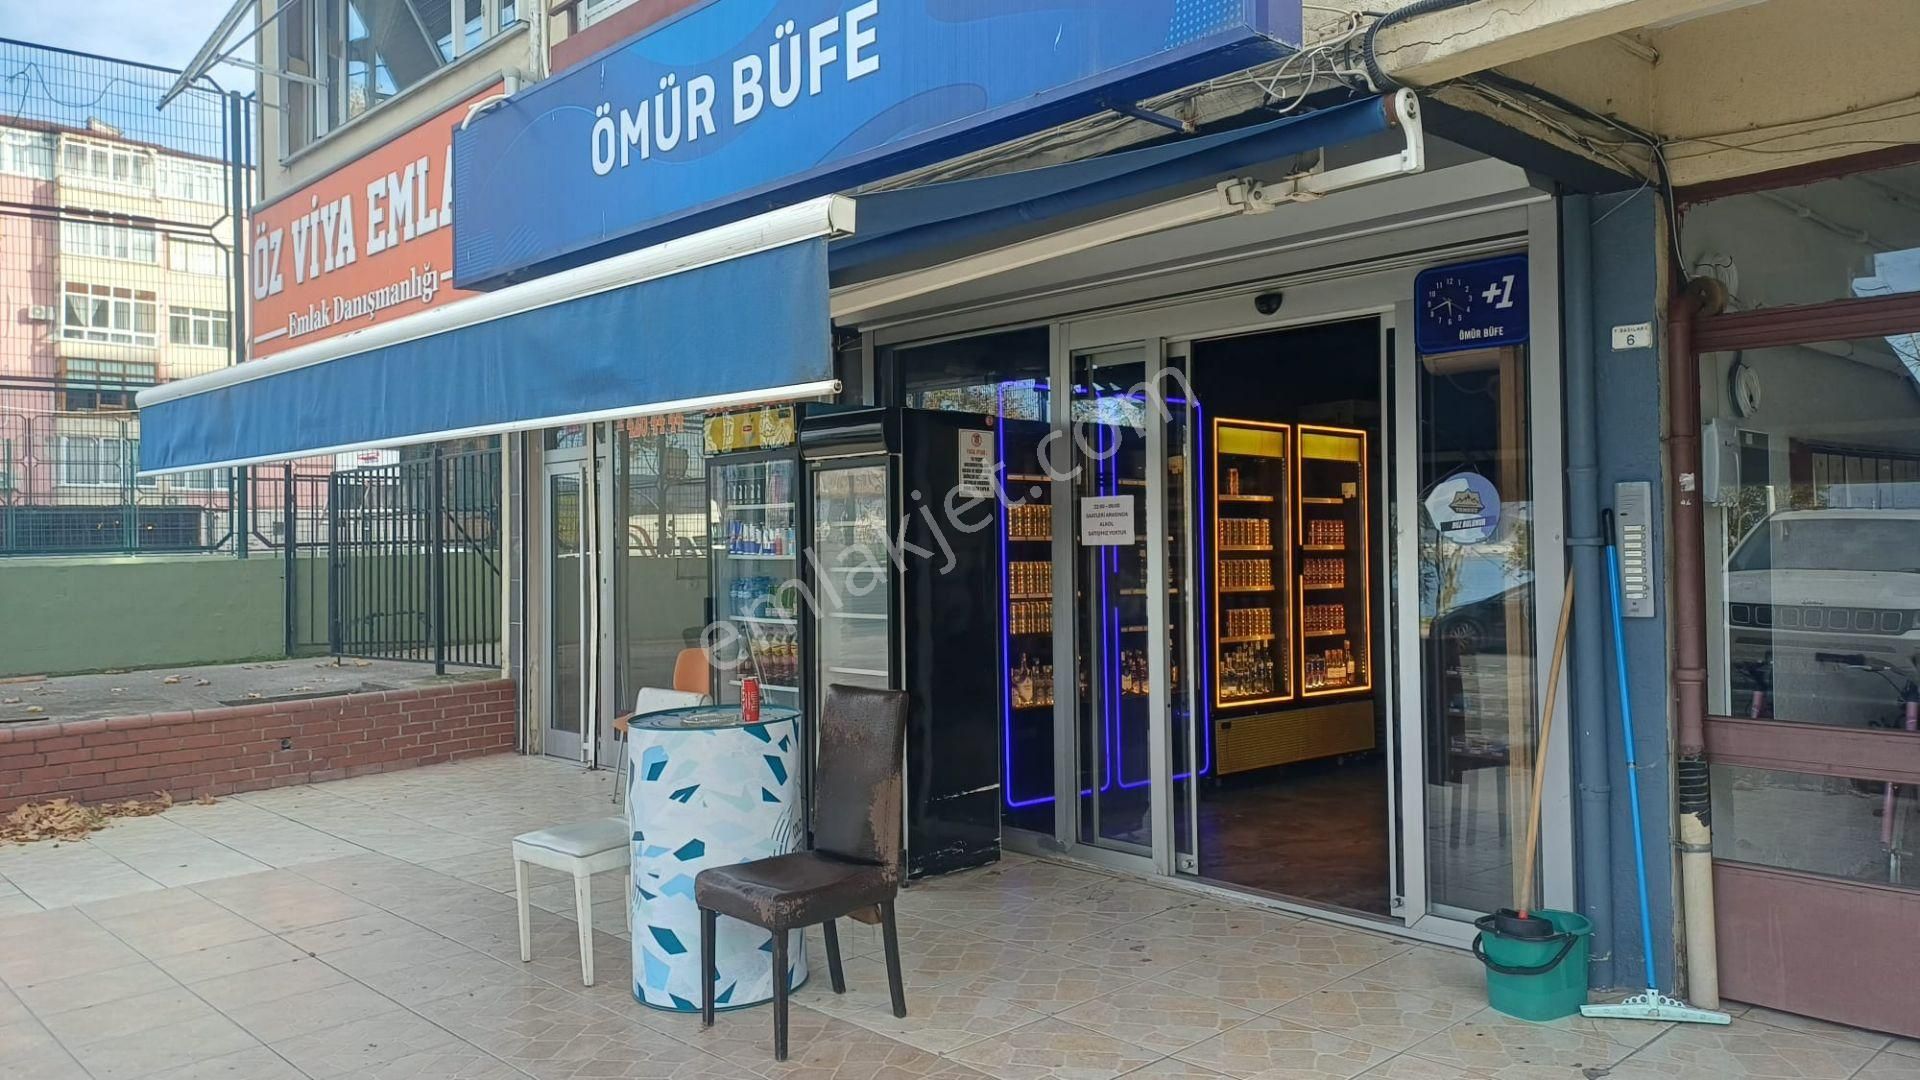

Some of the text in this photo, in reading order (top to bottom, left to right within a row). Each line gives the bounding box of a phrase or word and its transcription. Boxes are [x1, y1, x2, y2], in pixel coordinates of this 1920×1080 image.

[591, 0, 880, 176] ÖMÜR BÜFE
[254, 220, 284, 301] ÖZ
[291, 193, 357, 284] VİYA
[288, 261, 440, 339] Emlak Danışmanlığı
[1481, 274, 1515, 310] +1
[1459, 326, 1504, 341] ÖMÜR BÜFE
[1626, 334, 1635, 346] 6
